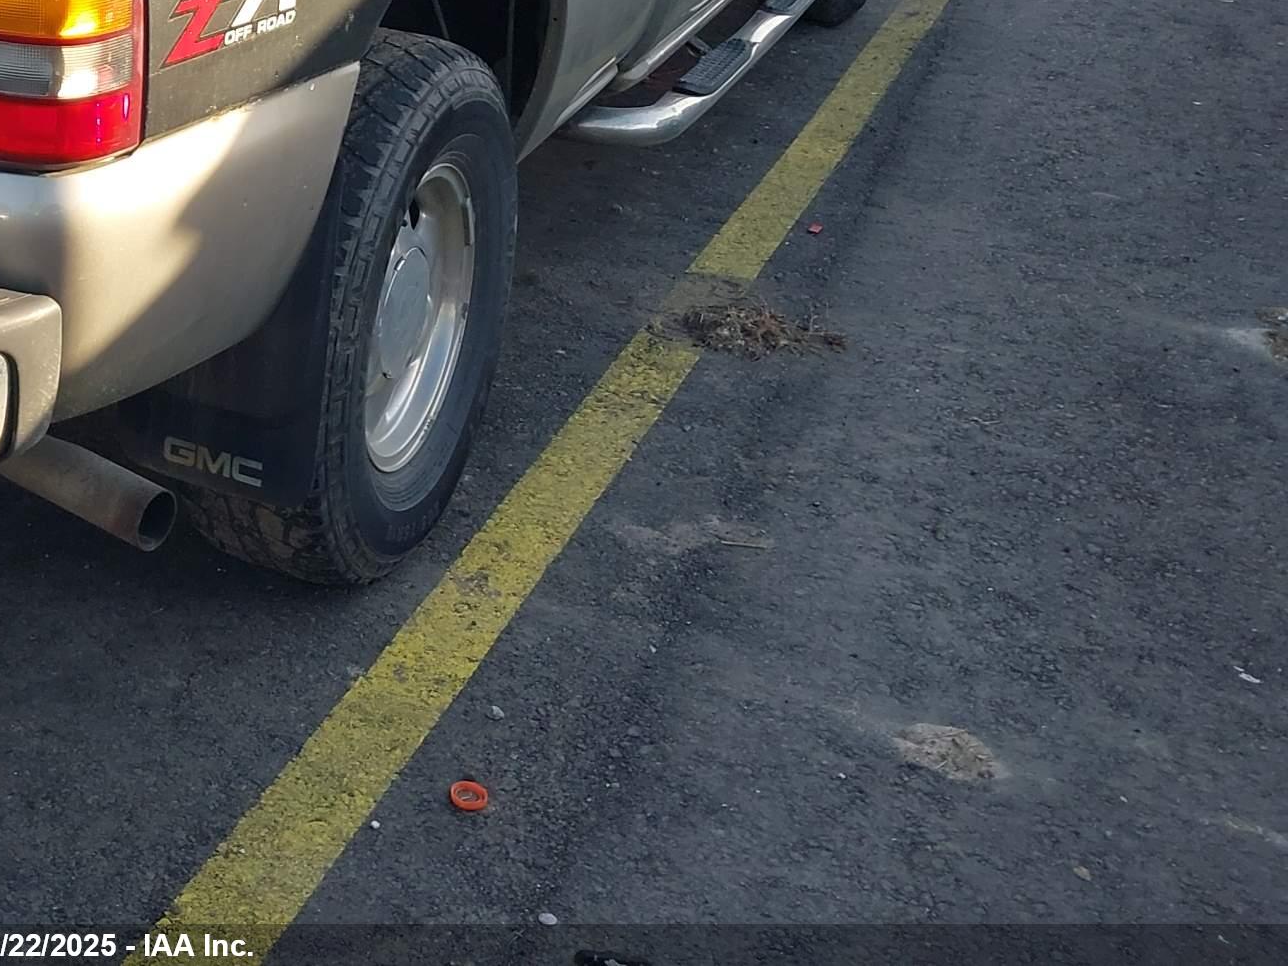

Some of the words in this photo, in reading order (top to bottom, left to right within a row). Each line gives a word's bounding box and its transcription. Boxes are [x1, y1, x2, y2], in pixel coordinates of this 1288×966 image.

[224, 24, 253, 46] OFF
[257, 9, 297, 35] ROAD
[163, 436, 263, 488] GMC
